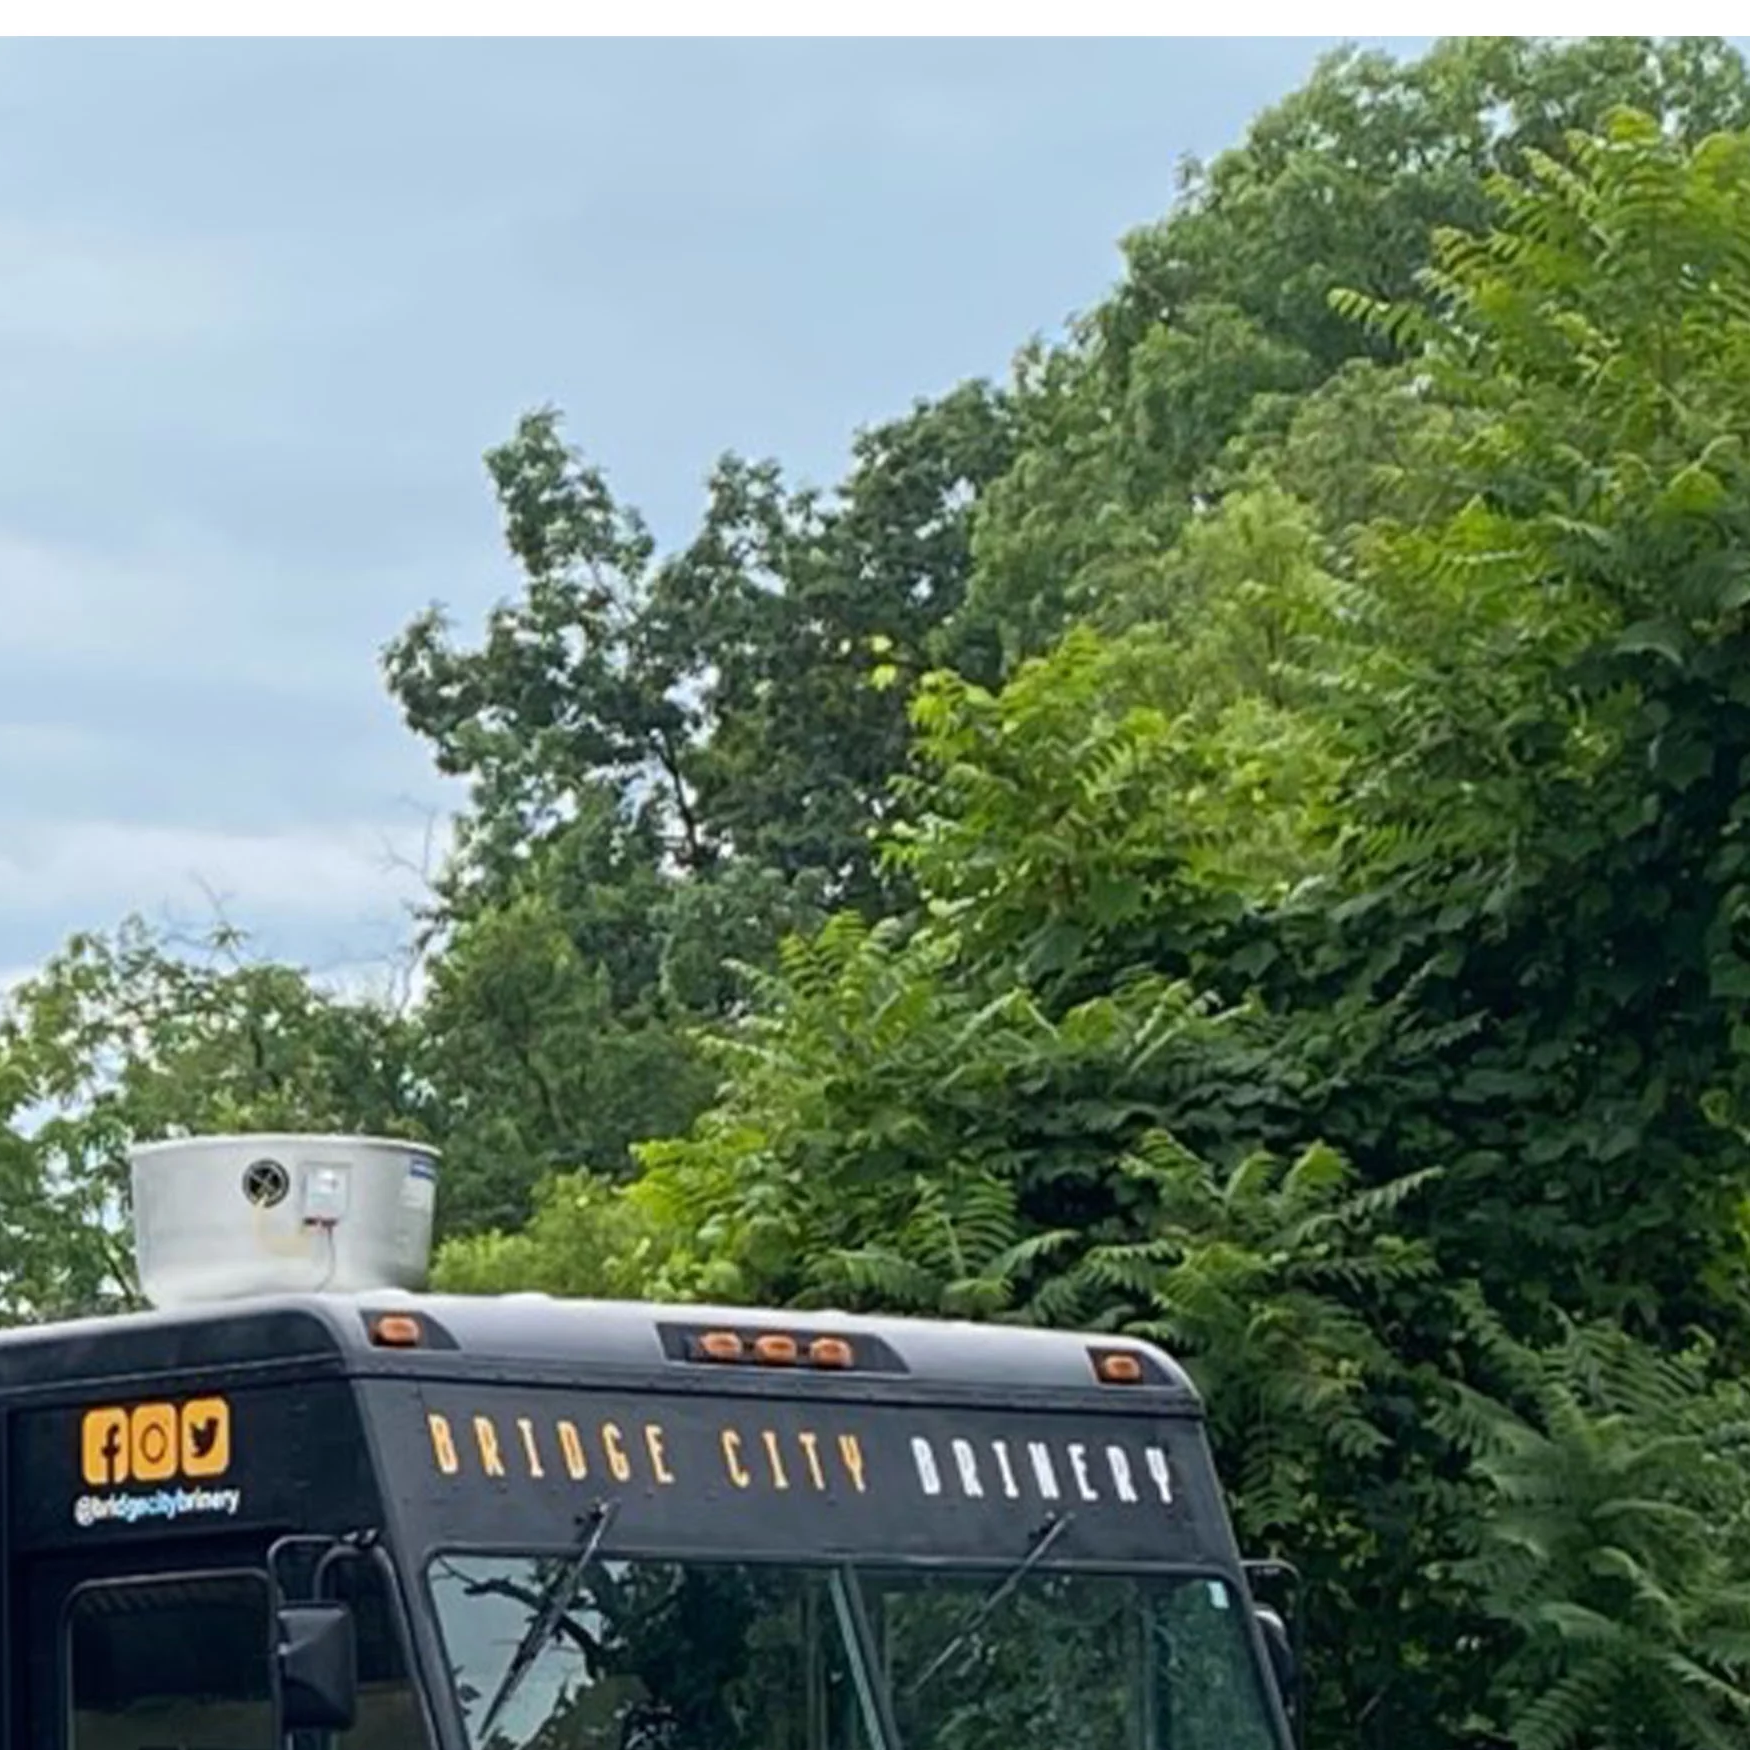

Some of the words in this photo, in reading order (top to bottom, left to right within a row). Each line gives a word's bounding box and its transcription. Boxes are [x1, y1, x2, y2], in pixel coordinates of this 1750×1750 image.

[427, 1413, 676, 1486] BRIDGE
[722, 1430, 867, 1494] CITY
[911, 1437, 1177, 1504] BRINERY
[74, 1486, 240, 1527] @bridgecitybrinery
